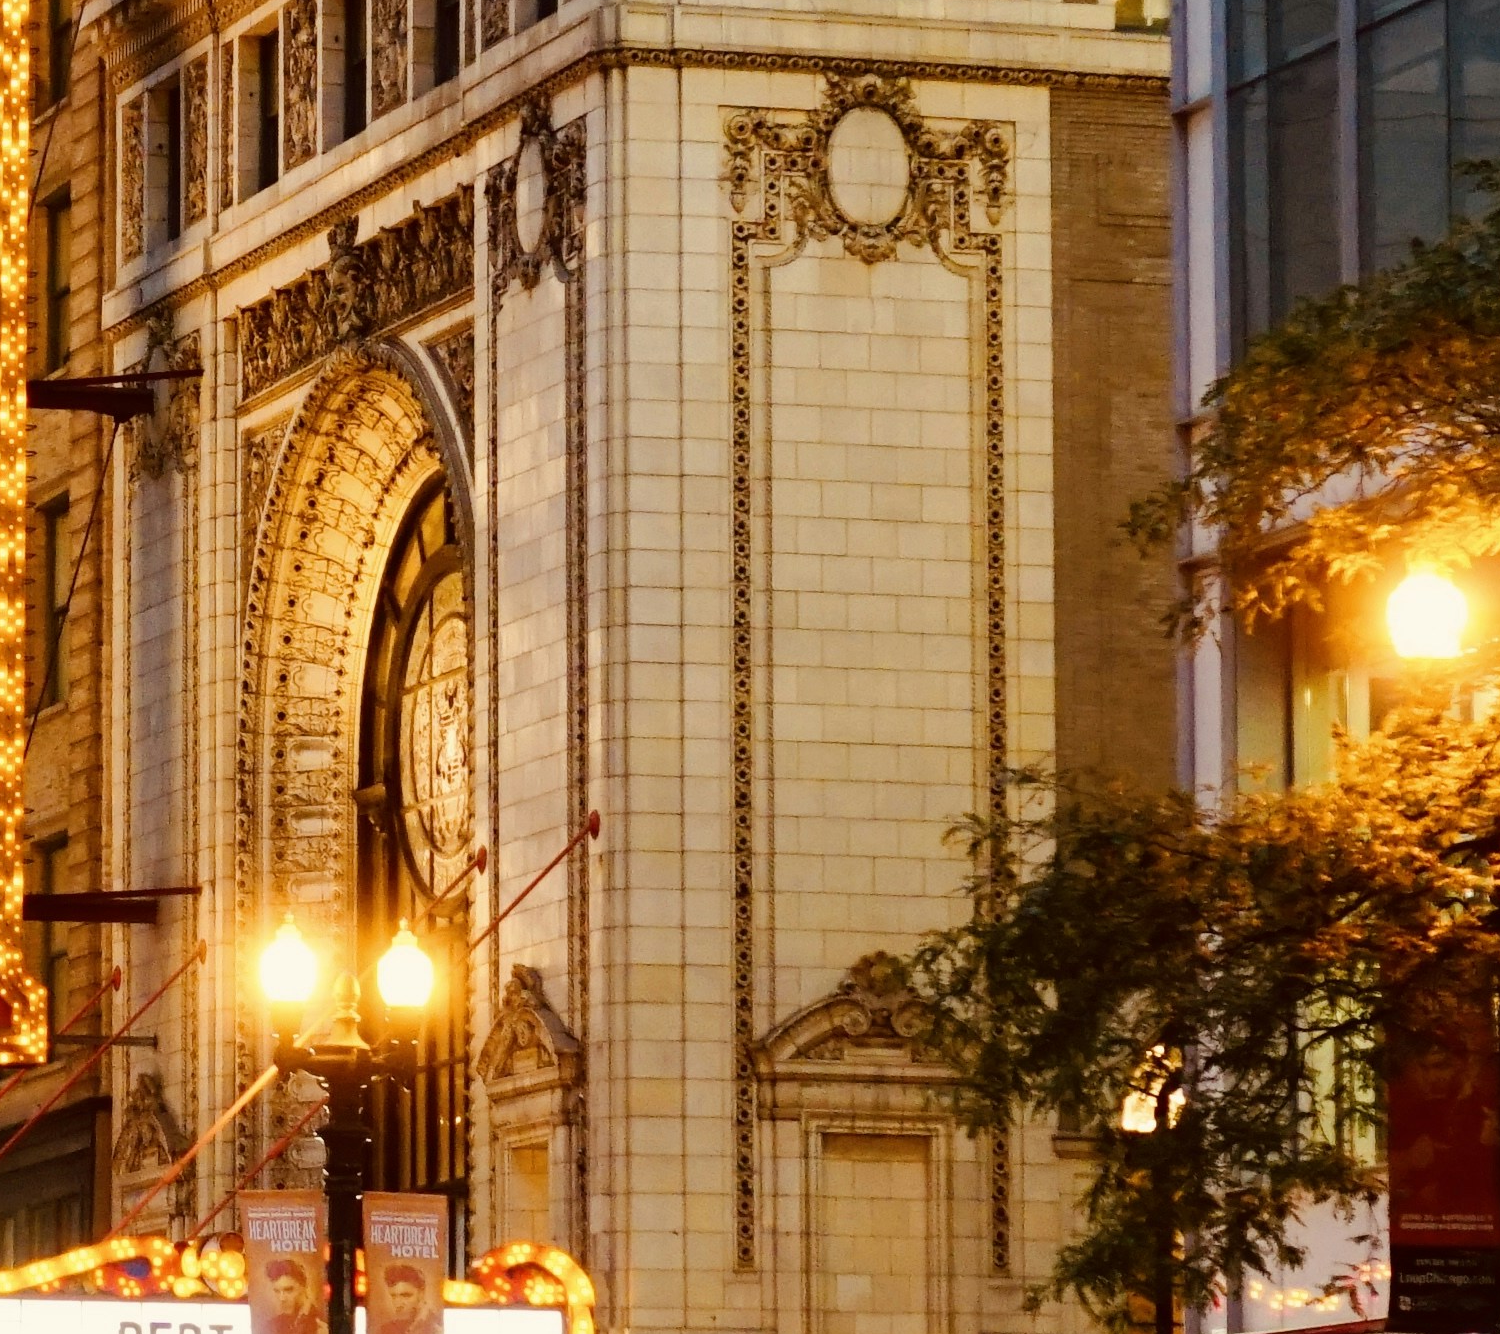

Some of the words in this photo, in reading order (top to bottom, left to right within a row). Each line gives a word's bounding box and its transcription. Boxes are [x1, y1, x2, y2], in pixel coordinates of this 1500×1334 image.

[248, 1220, 317, 1241] HEARTBREAK
[370, 1224, 439, 1246] HEARTBREAK
[271, 1240, 317, 1253] HOTEL
[391, 1246, 439, 1259] HOTEL
